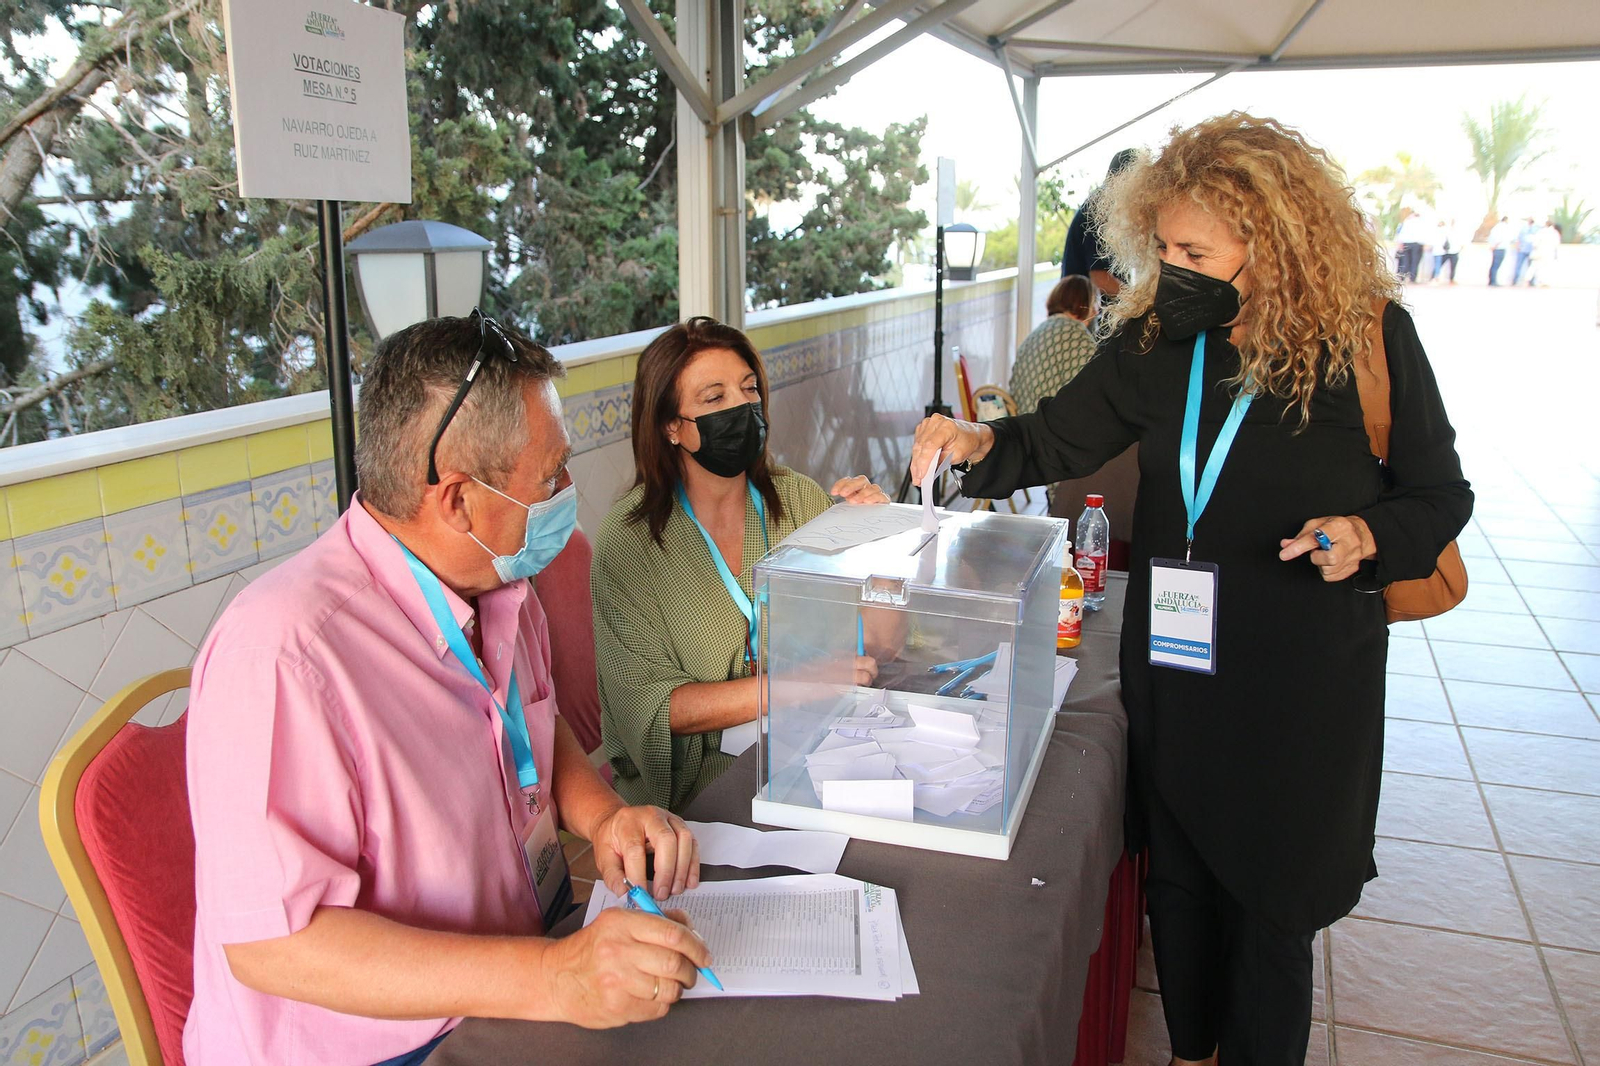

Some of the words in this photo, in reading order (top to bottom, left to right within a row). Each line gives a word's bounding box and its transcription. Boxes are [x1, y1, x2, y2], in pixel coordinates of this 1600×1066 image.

[293, 53, 361, 79] VOTACIONES
[303, 79, 333, 97] MESA
[351, 88, 357, 101] 5
[282, 117, 334, 138] NAVARRO
[336, 126, 368, 142] OJEDA
[370, 129, 377, 142] A
[293, 143, 318, 159] RUIZ
[321, 145, 371, 164] MARTÍNEZ
[1156, 597, 1201, 610] ANDALUCÍA
[1163, 591, 1194, 601] FUERZA
[1153, 640, 1208, 654] COMPROMISARIOS
